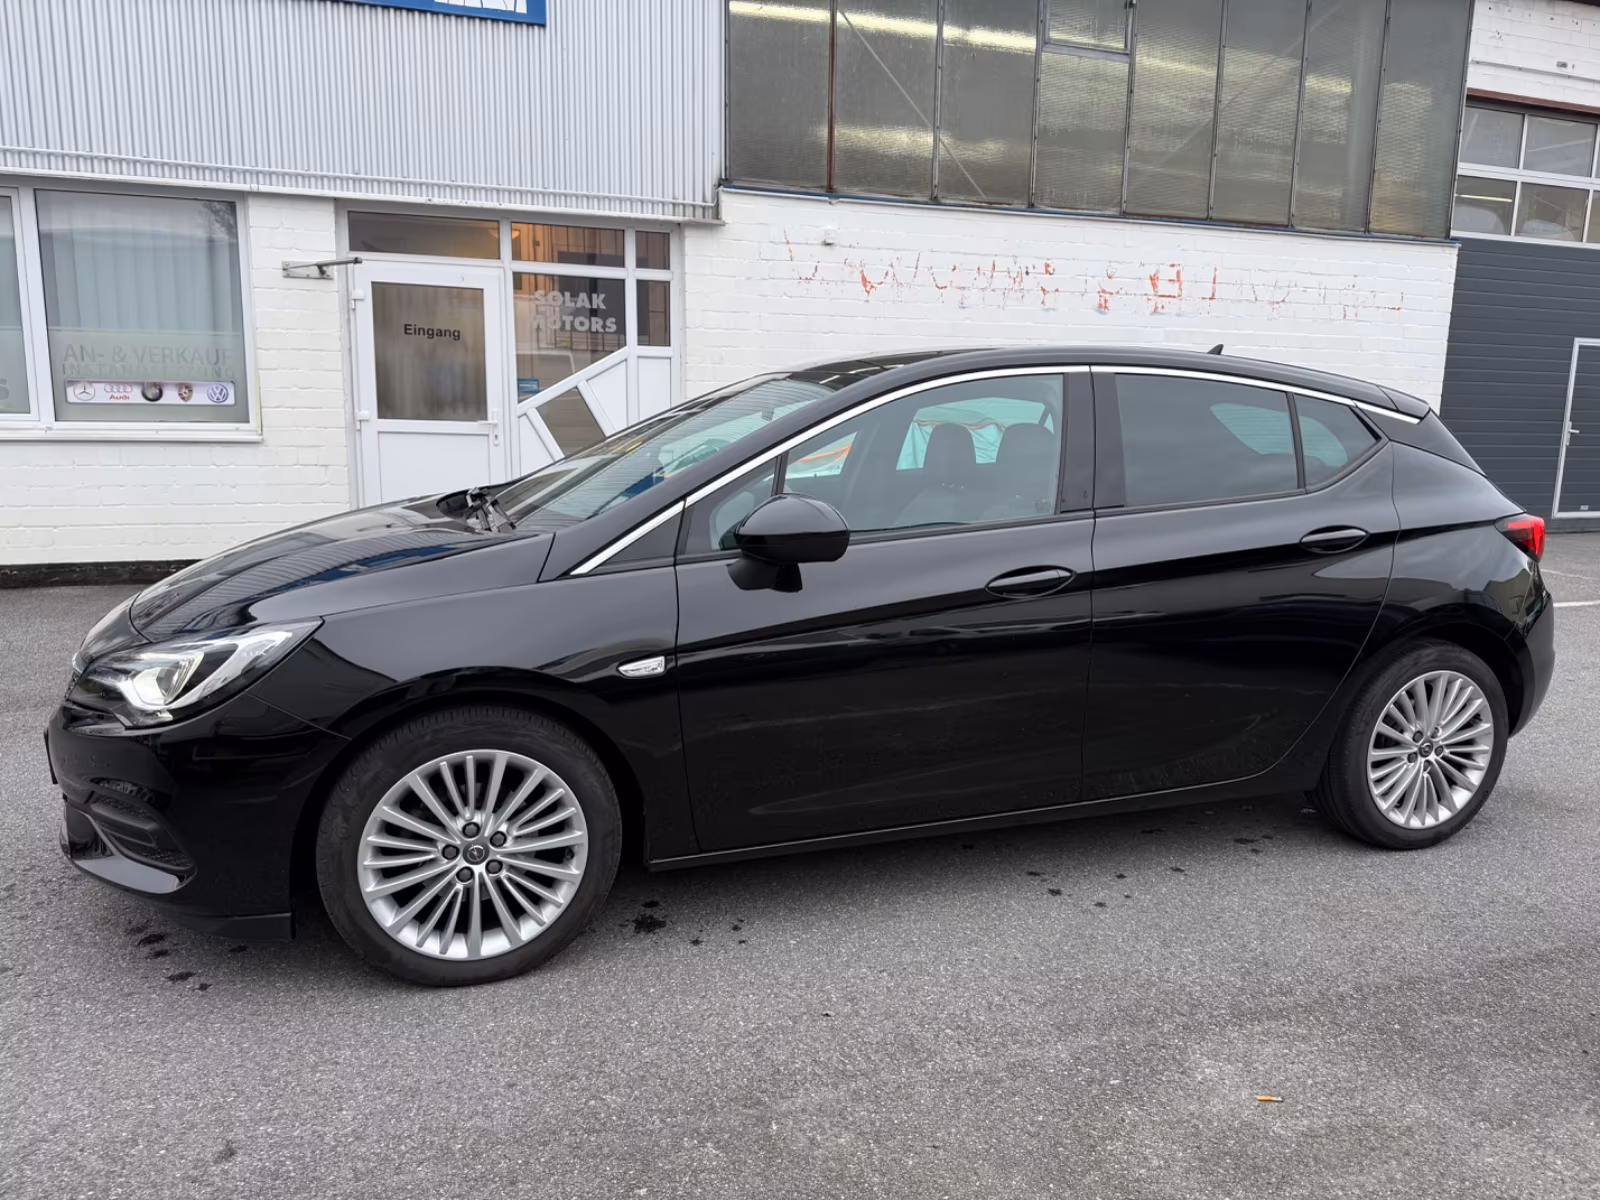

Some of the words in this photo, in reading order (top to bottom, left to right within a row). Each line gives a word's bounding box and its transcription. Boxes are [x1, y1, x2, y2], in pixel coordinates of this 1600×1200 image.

[534, 290, 607, 309] SOLAK
[404, 323, 461, 341] Eingang
[530, 314, 617, 333] MOTORS
[64, 344, 105, 362] AN-
[112, 345, 129, 363] &
[131, 345, 232, 366] VERKAUF
